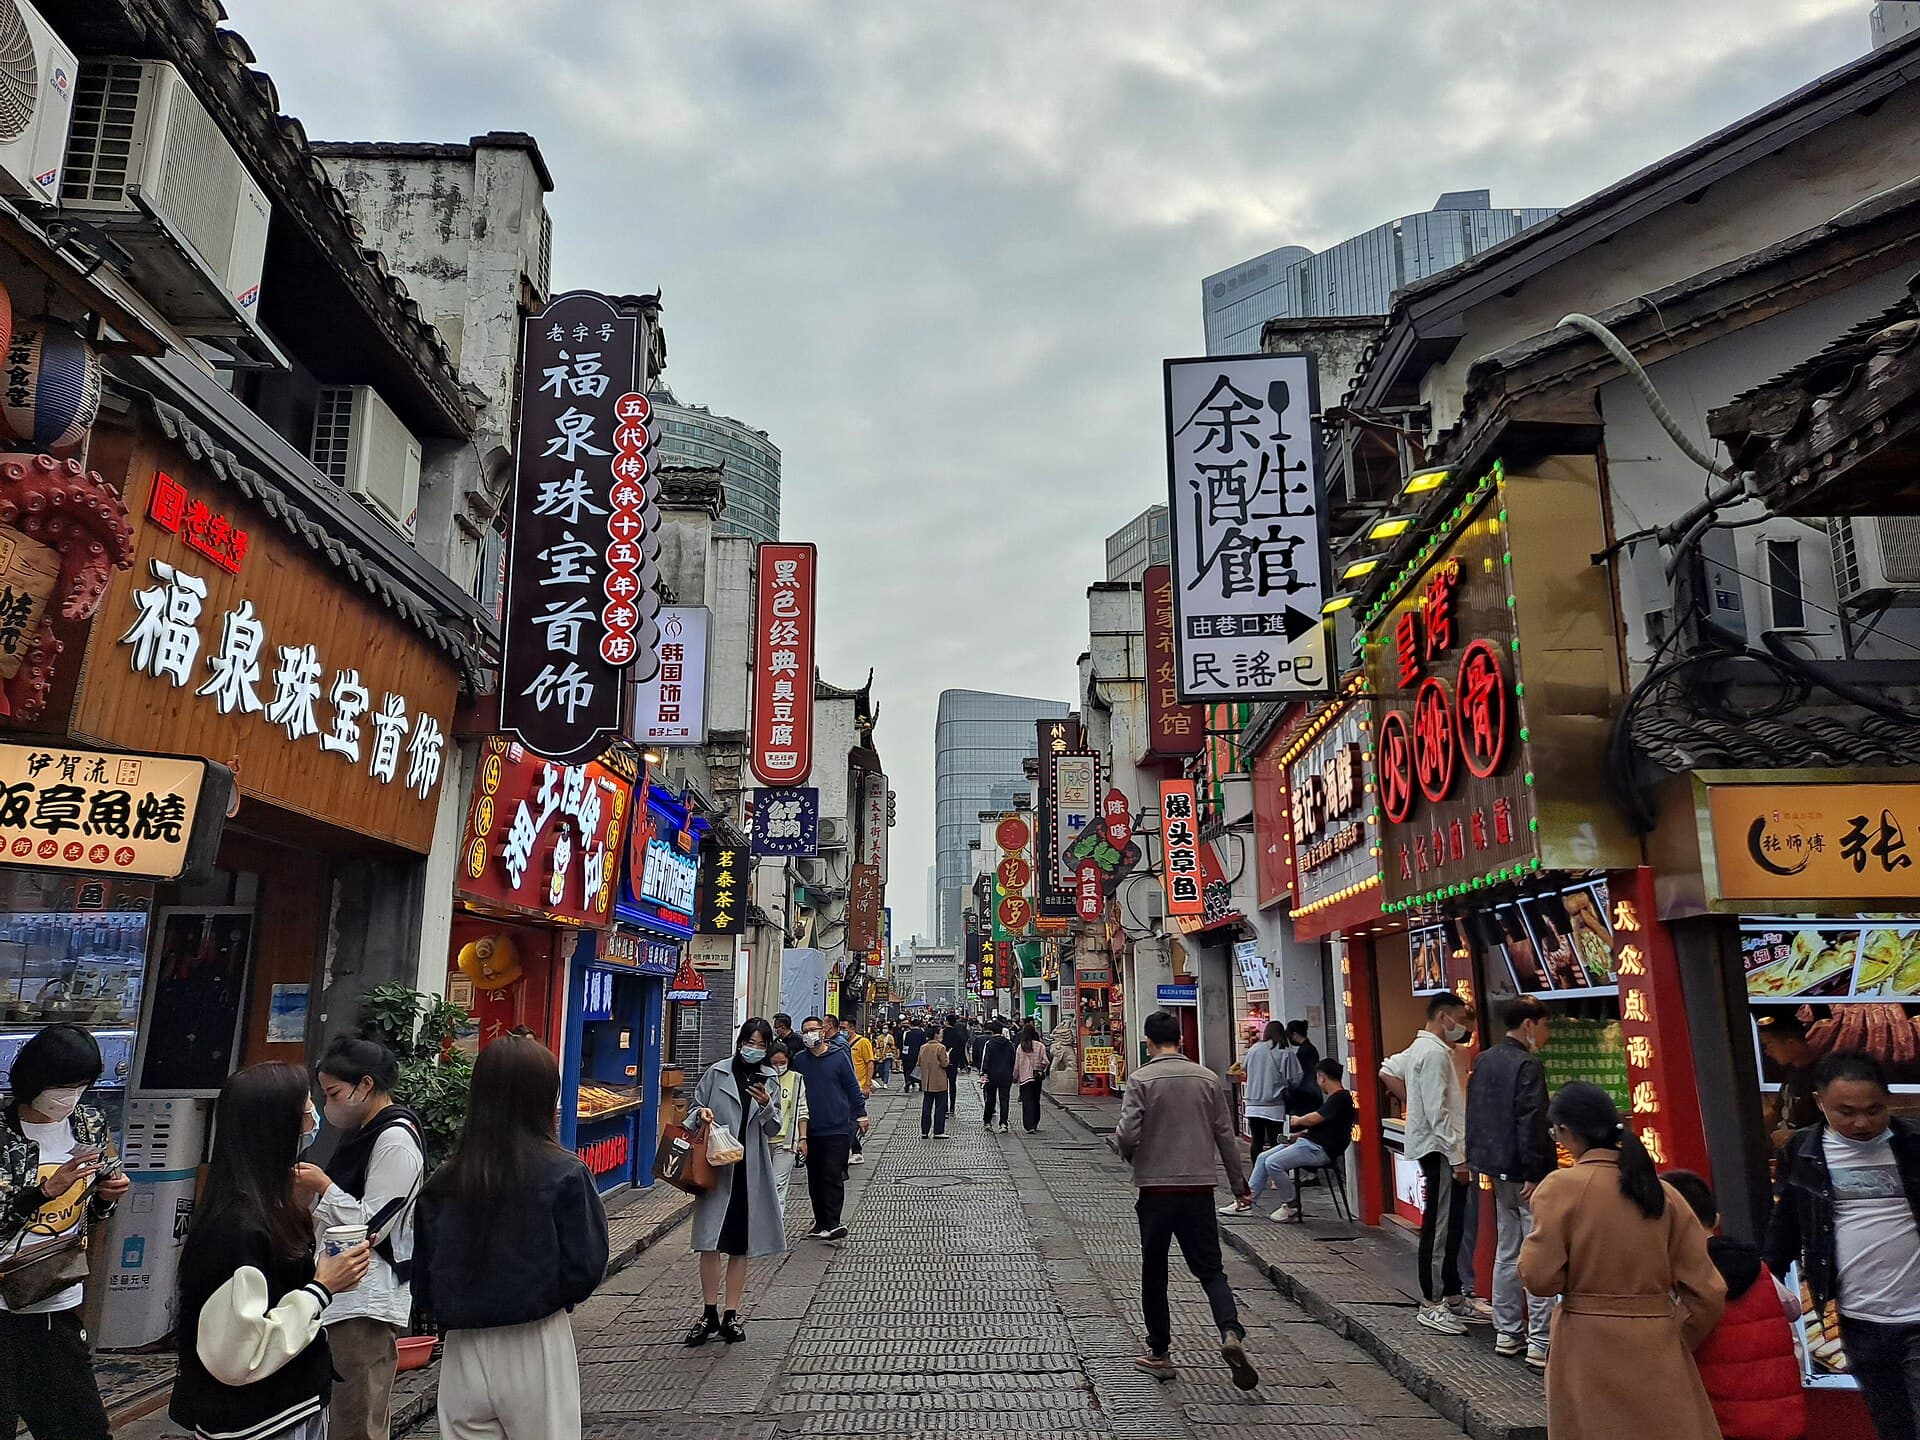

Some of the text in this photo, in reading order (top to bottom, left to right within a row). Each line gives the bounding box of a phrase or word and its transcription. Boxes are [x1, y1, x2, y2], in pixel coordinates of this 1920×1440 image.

[546, 323, 615, 343] 老字号
[520, 350, 614, 724] 福泉珠宝首饰
[605, 400, 645, 659] 五代传承十五年老店
[768, 559, 801, 746] 黑色经典臭豆腐
[1192, 614, 1286, 637] 由巷口進
[119, 559, 444, 799] 福泉珠宝首饰
[658, 643, 684, 723] 韩国饰品
[1189, 650, 1323, 690] 民謠吧
[27, 753, 110, 785] 伊賀流
[804, 844, 816, 852] 2F
[1166, 793, 1199, 902] 爆头章鱼
[1762, 833, 1827, 854] 张师傅
[711, 850, 737, 929] 茗泰茶舍
[1081, 867, 1098, 913] 臭豆腐
[1613, 900, 1668, 1164] 大众点评必点
[782, 1088, 788, 1099] C
